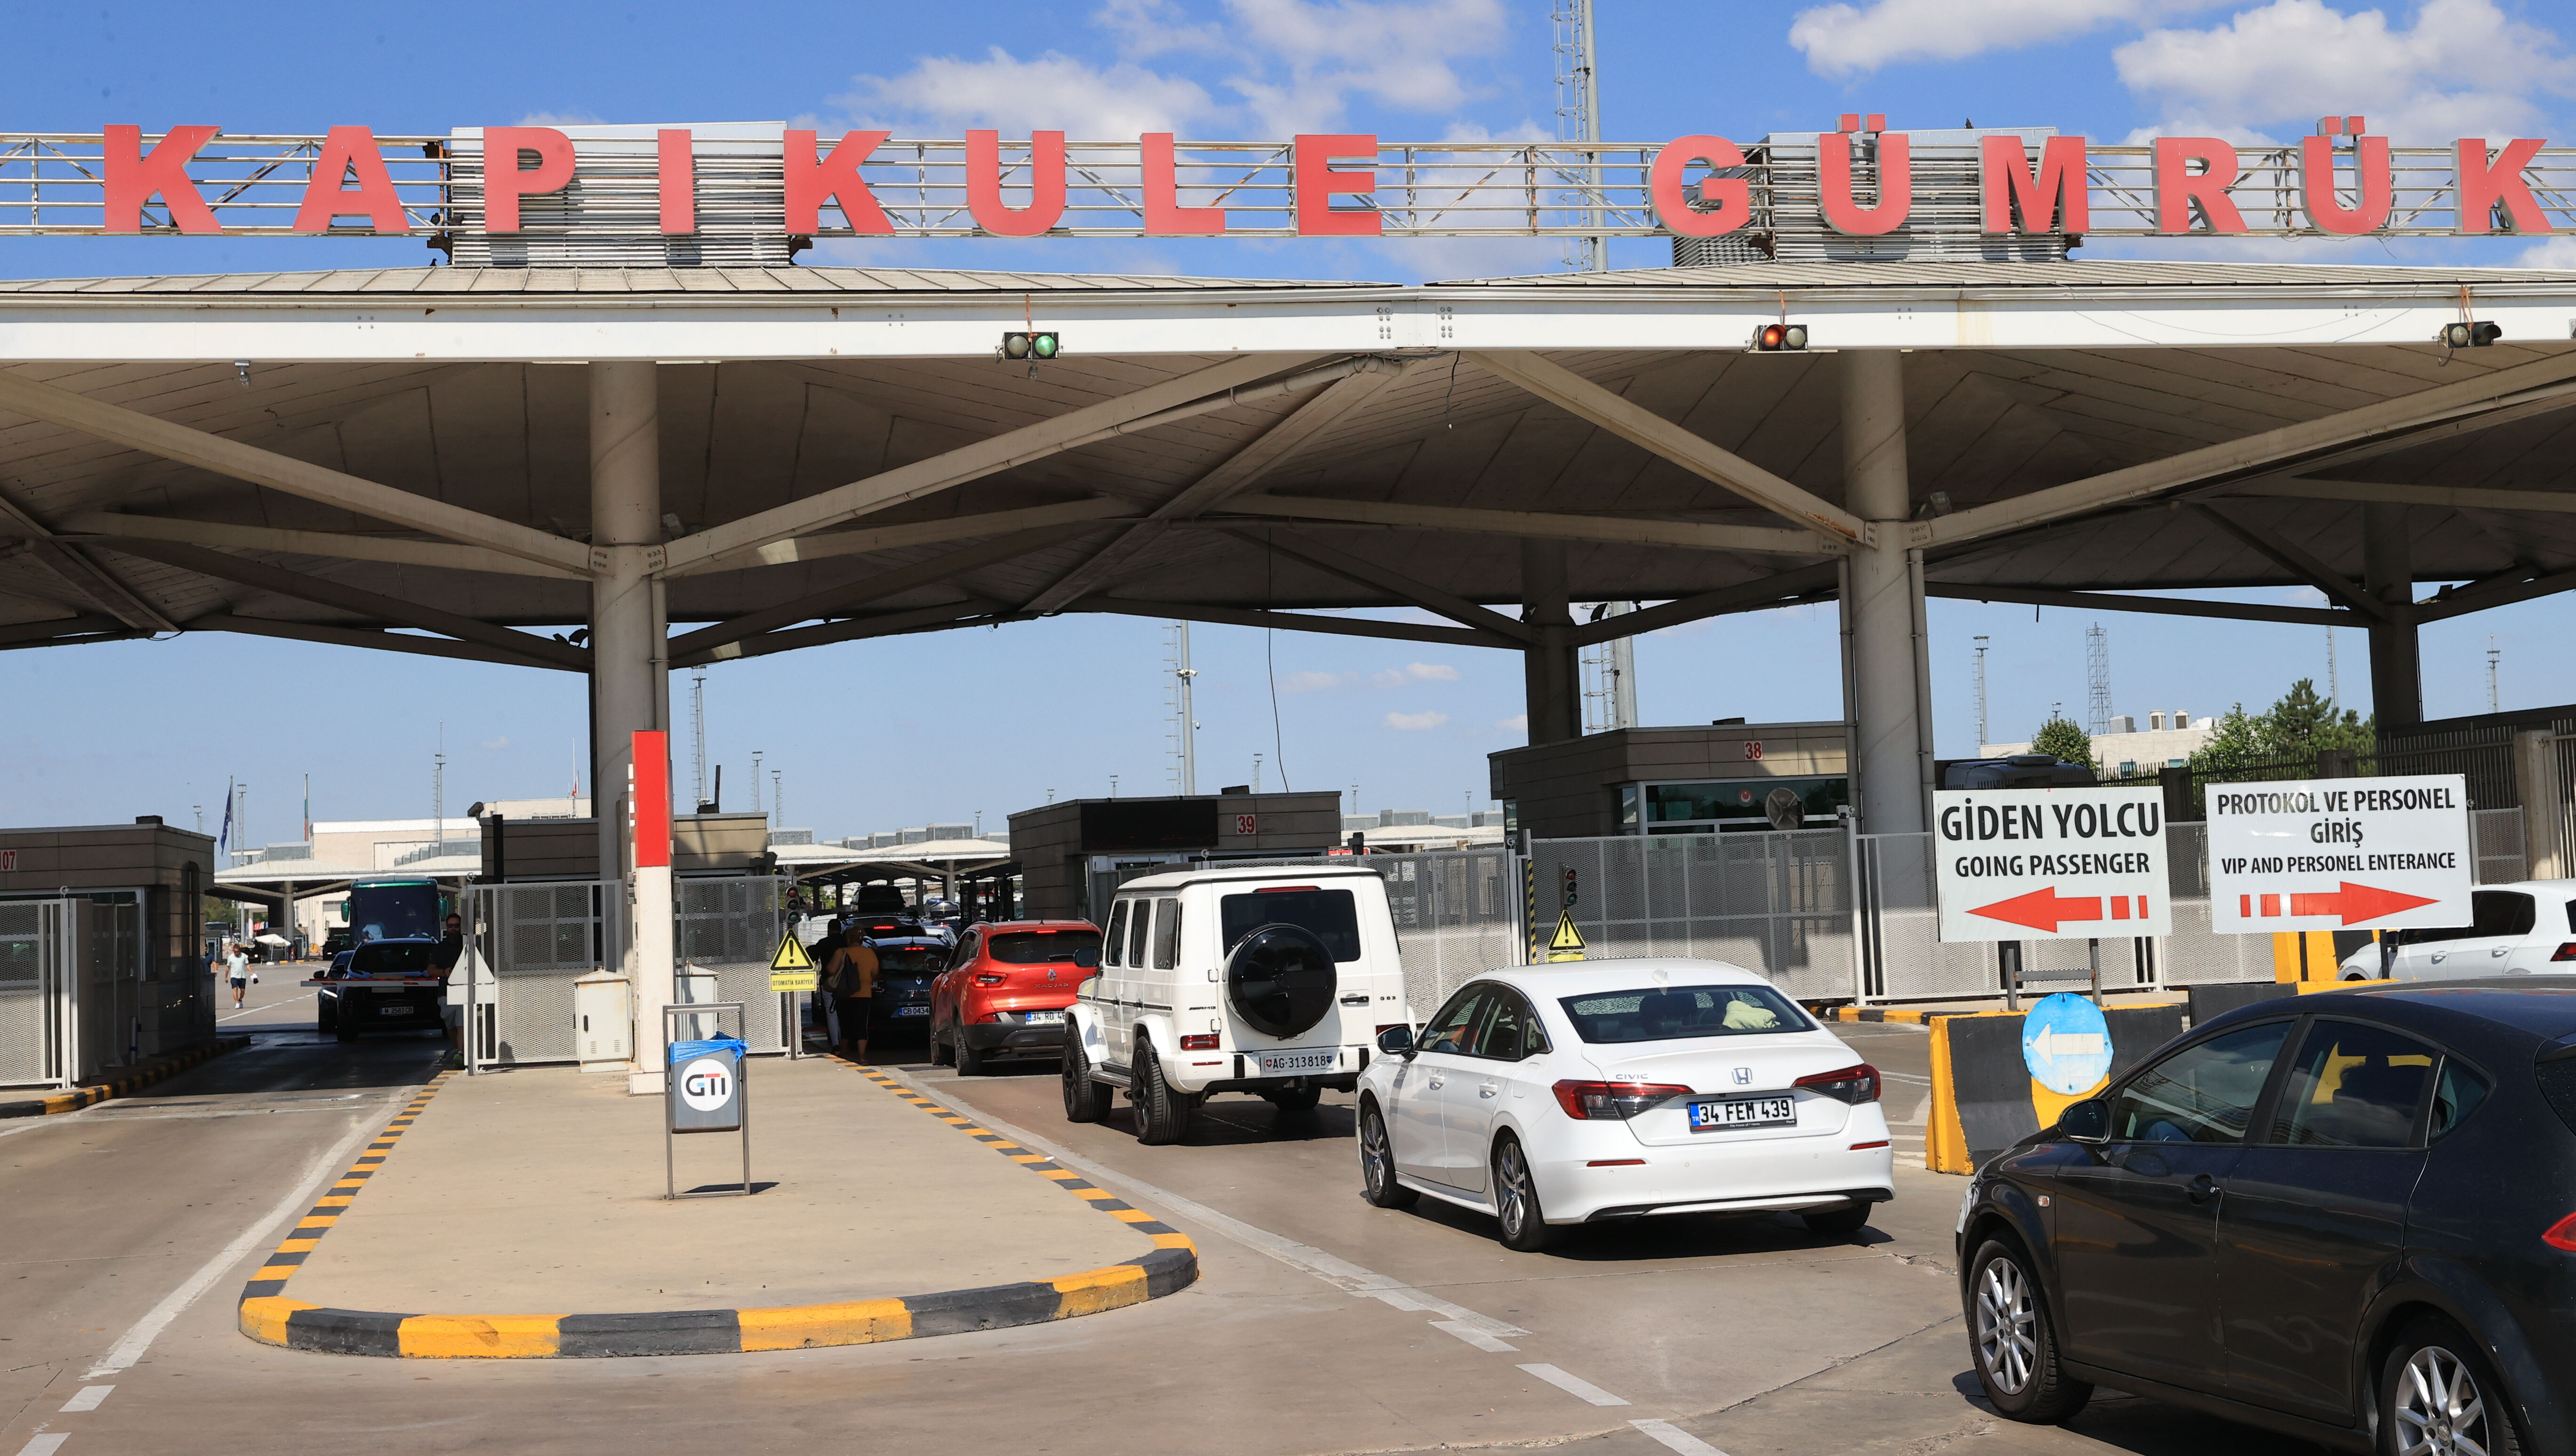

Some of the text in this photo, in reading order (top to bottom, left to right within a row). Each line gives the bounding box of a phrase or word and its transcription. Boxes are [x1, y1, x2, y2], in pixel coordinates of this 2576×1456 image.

[103, 113, 2555, 238] KAPIKULE GÜMRÜK
[1745, 742, 1762, 759] 38
[2218, 788, 2455, 815] PROTOKOL VE PERSONEL
[1238, 815, 1255, 833] 39
[1941, 798, 2159, 840] GİDEN YOLCU
[2310, 817, 2363, 848] GİRİŞ
[0, 851, 16, 870] 07
[1956, 853, 2150, 877] GOING PASSENGER
[2222, 852, 2456, 874] VIP AND PERSONEL ENTERANCE
[1032, 1013, 1041, 1021] 34
[1700, 1100, 1789, 1123] 34 FEM 439
